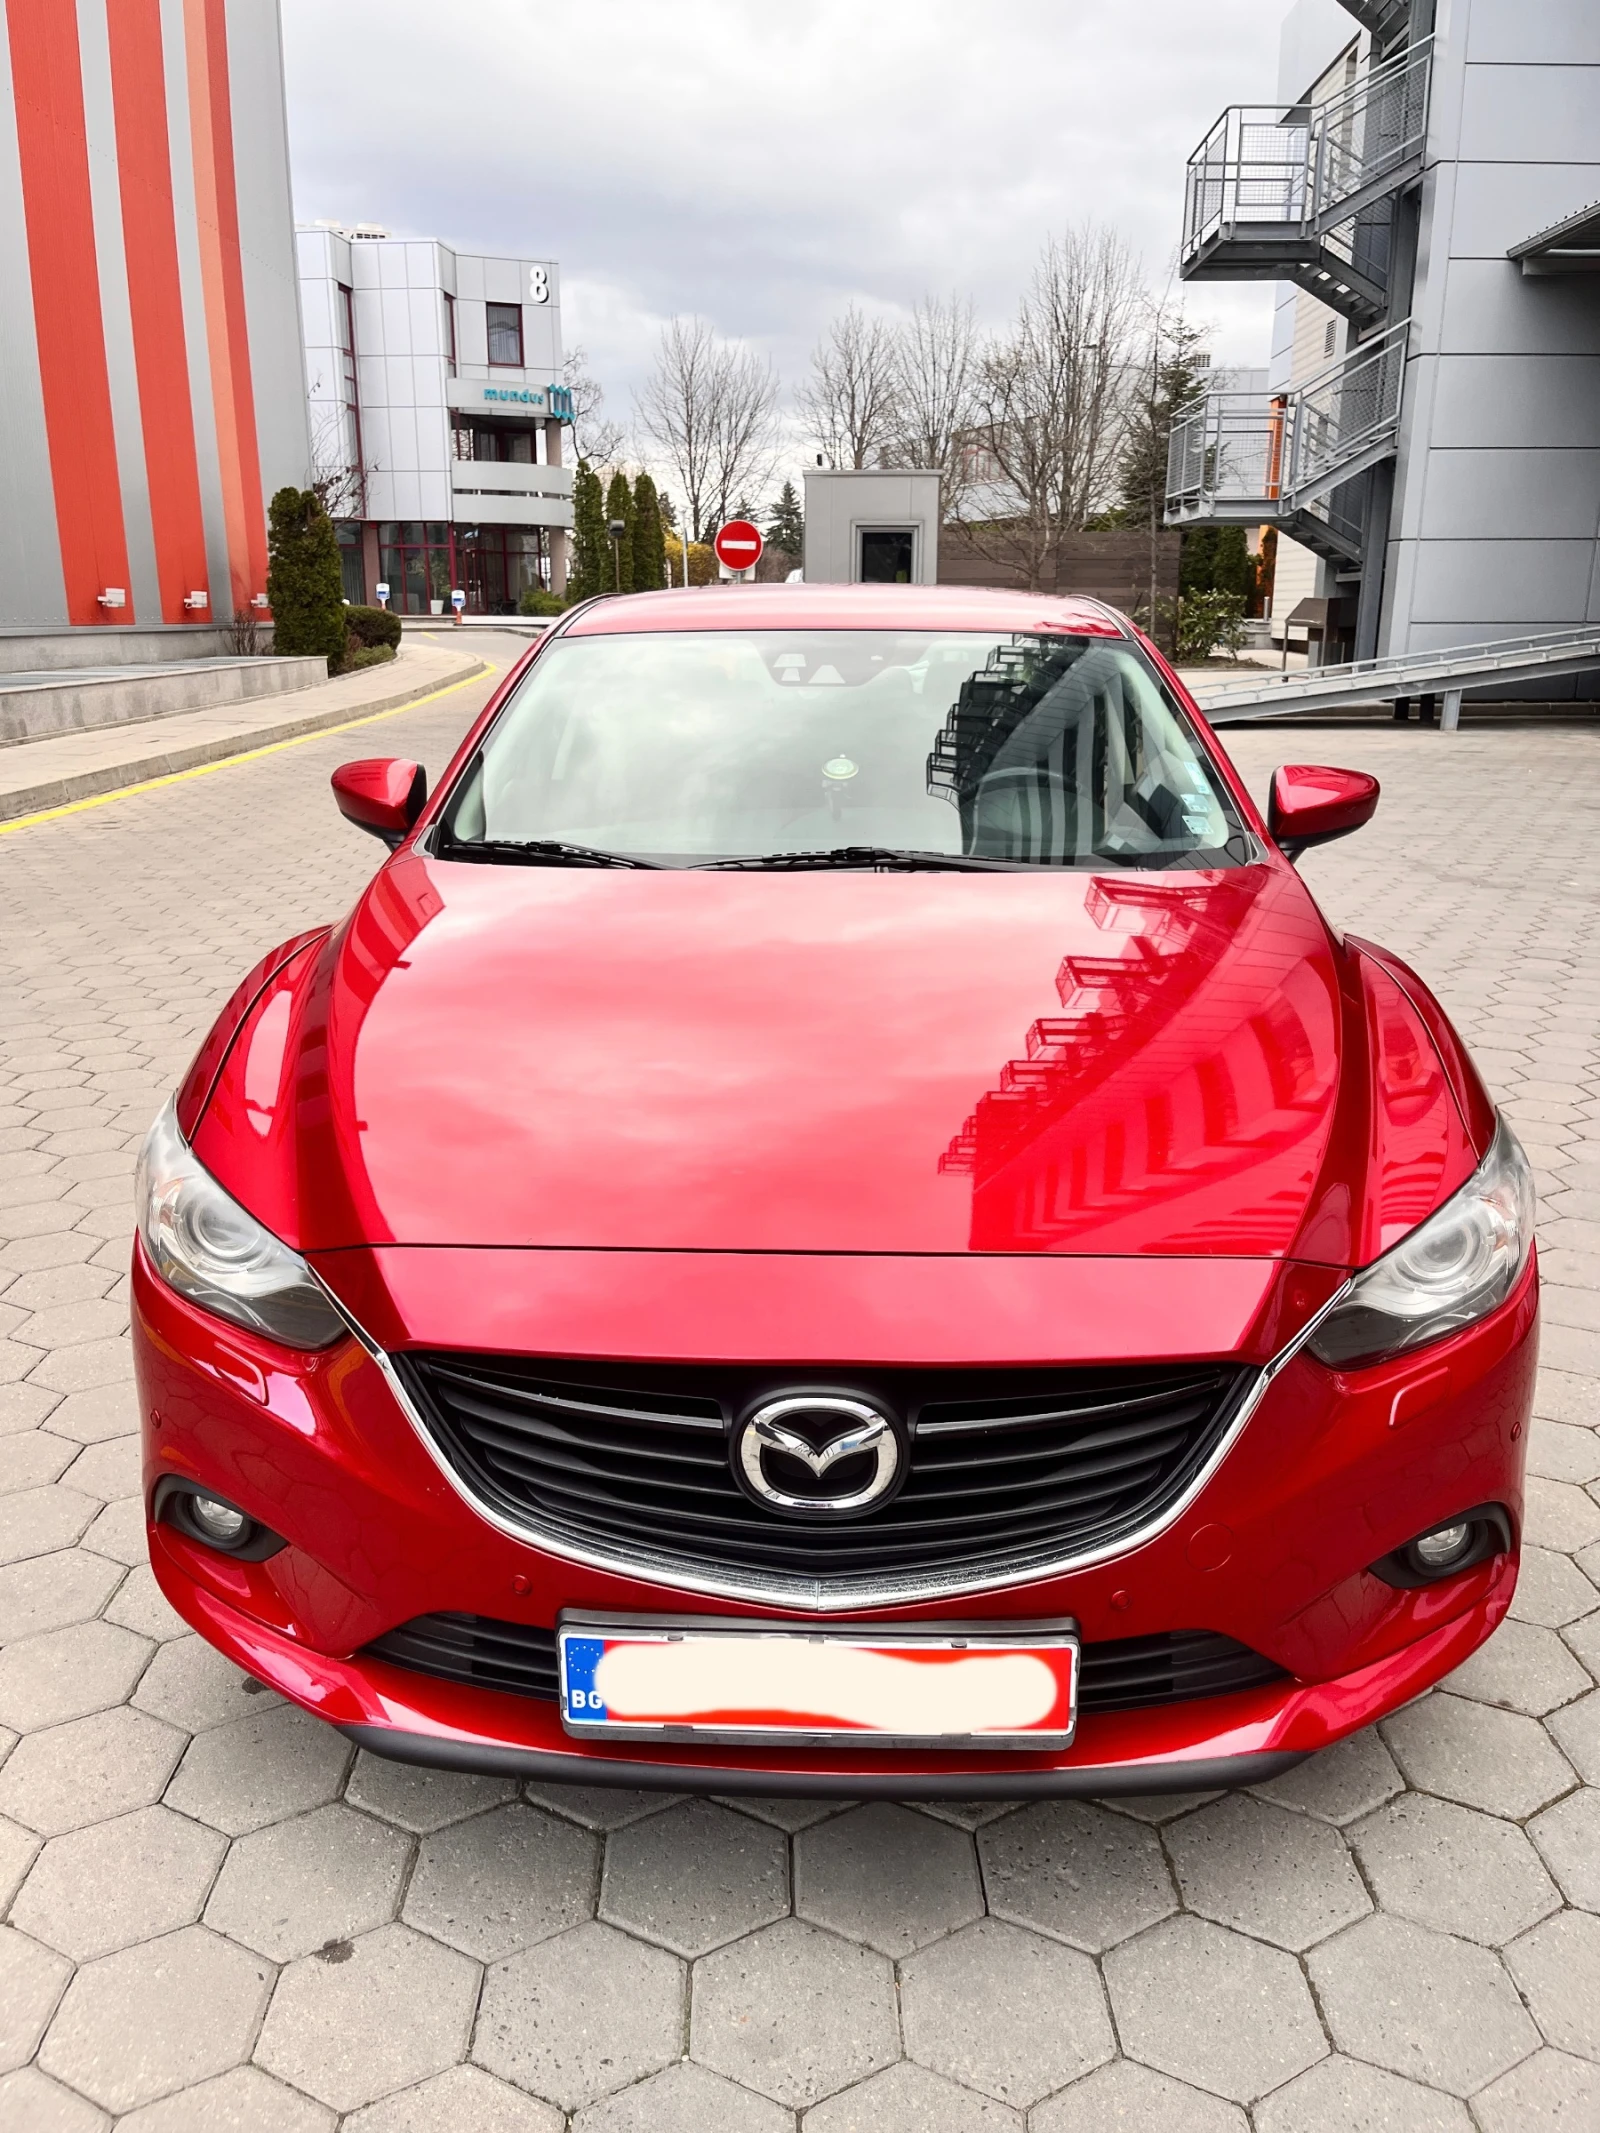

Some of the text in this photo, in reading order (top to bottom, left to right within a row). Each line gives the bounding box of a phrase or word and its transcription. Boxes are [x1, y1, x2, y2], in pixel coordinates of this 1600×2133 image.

[530, 265, 549, 303] 8
[484, 388, 544, 405] mundus
[571, 1689, 603, 1709] BG
